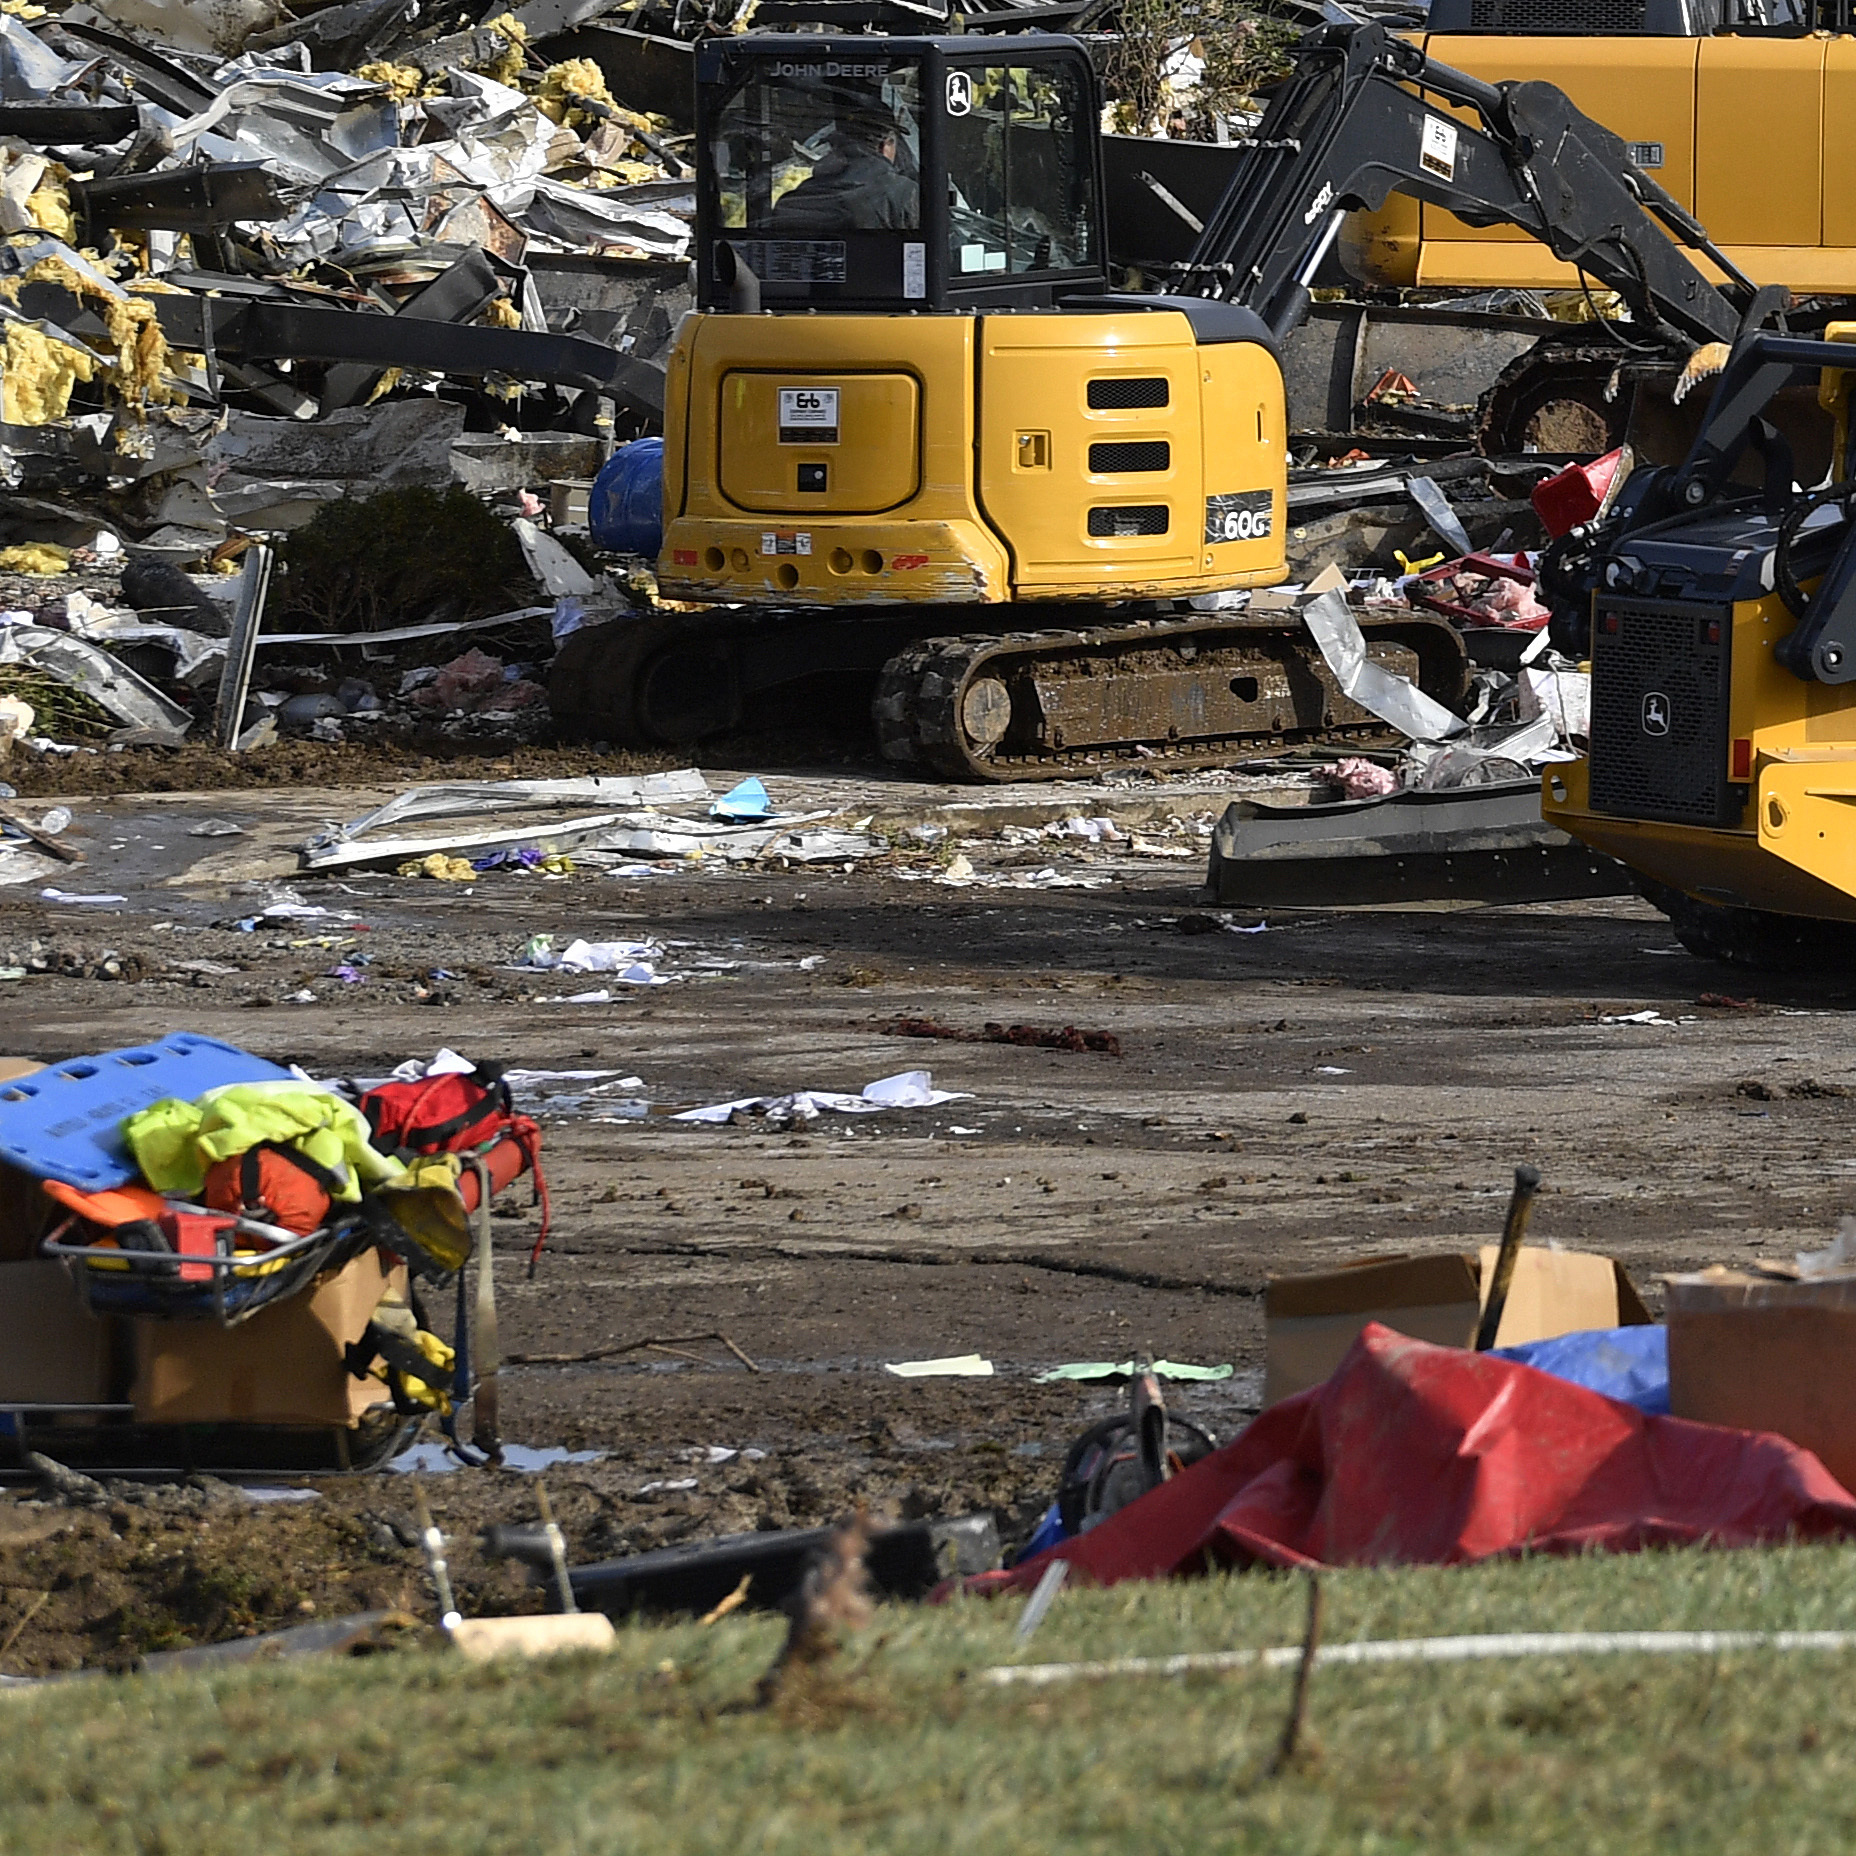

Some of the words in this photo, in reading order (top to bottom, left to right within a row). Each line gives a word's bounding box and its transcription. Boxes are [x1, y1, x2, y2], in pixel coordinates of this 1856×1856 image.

[770, 61, 822, 78] JOHN
[826, 61, 889, 78] DEERE
[796, 392, 821, 409] Erb
[1224, 509, 1266, 540] 60G
